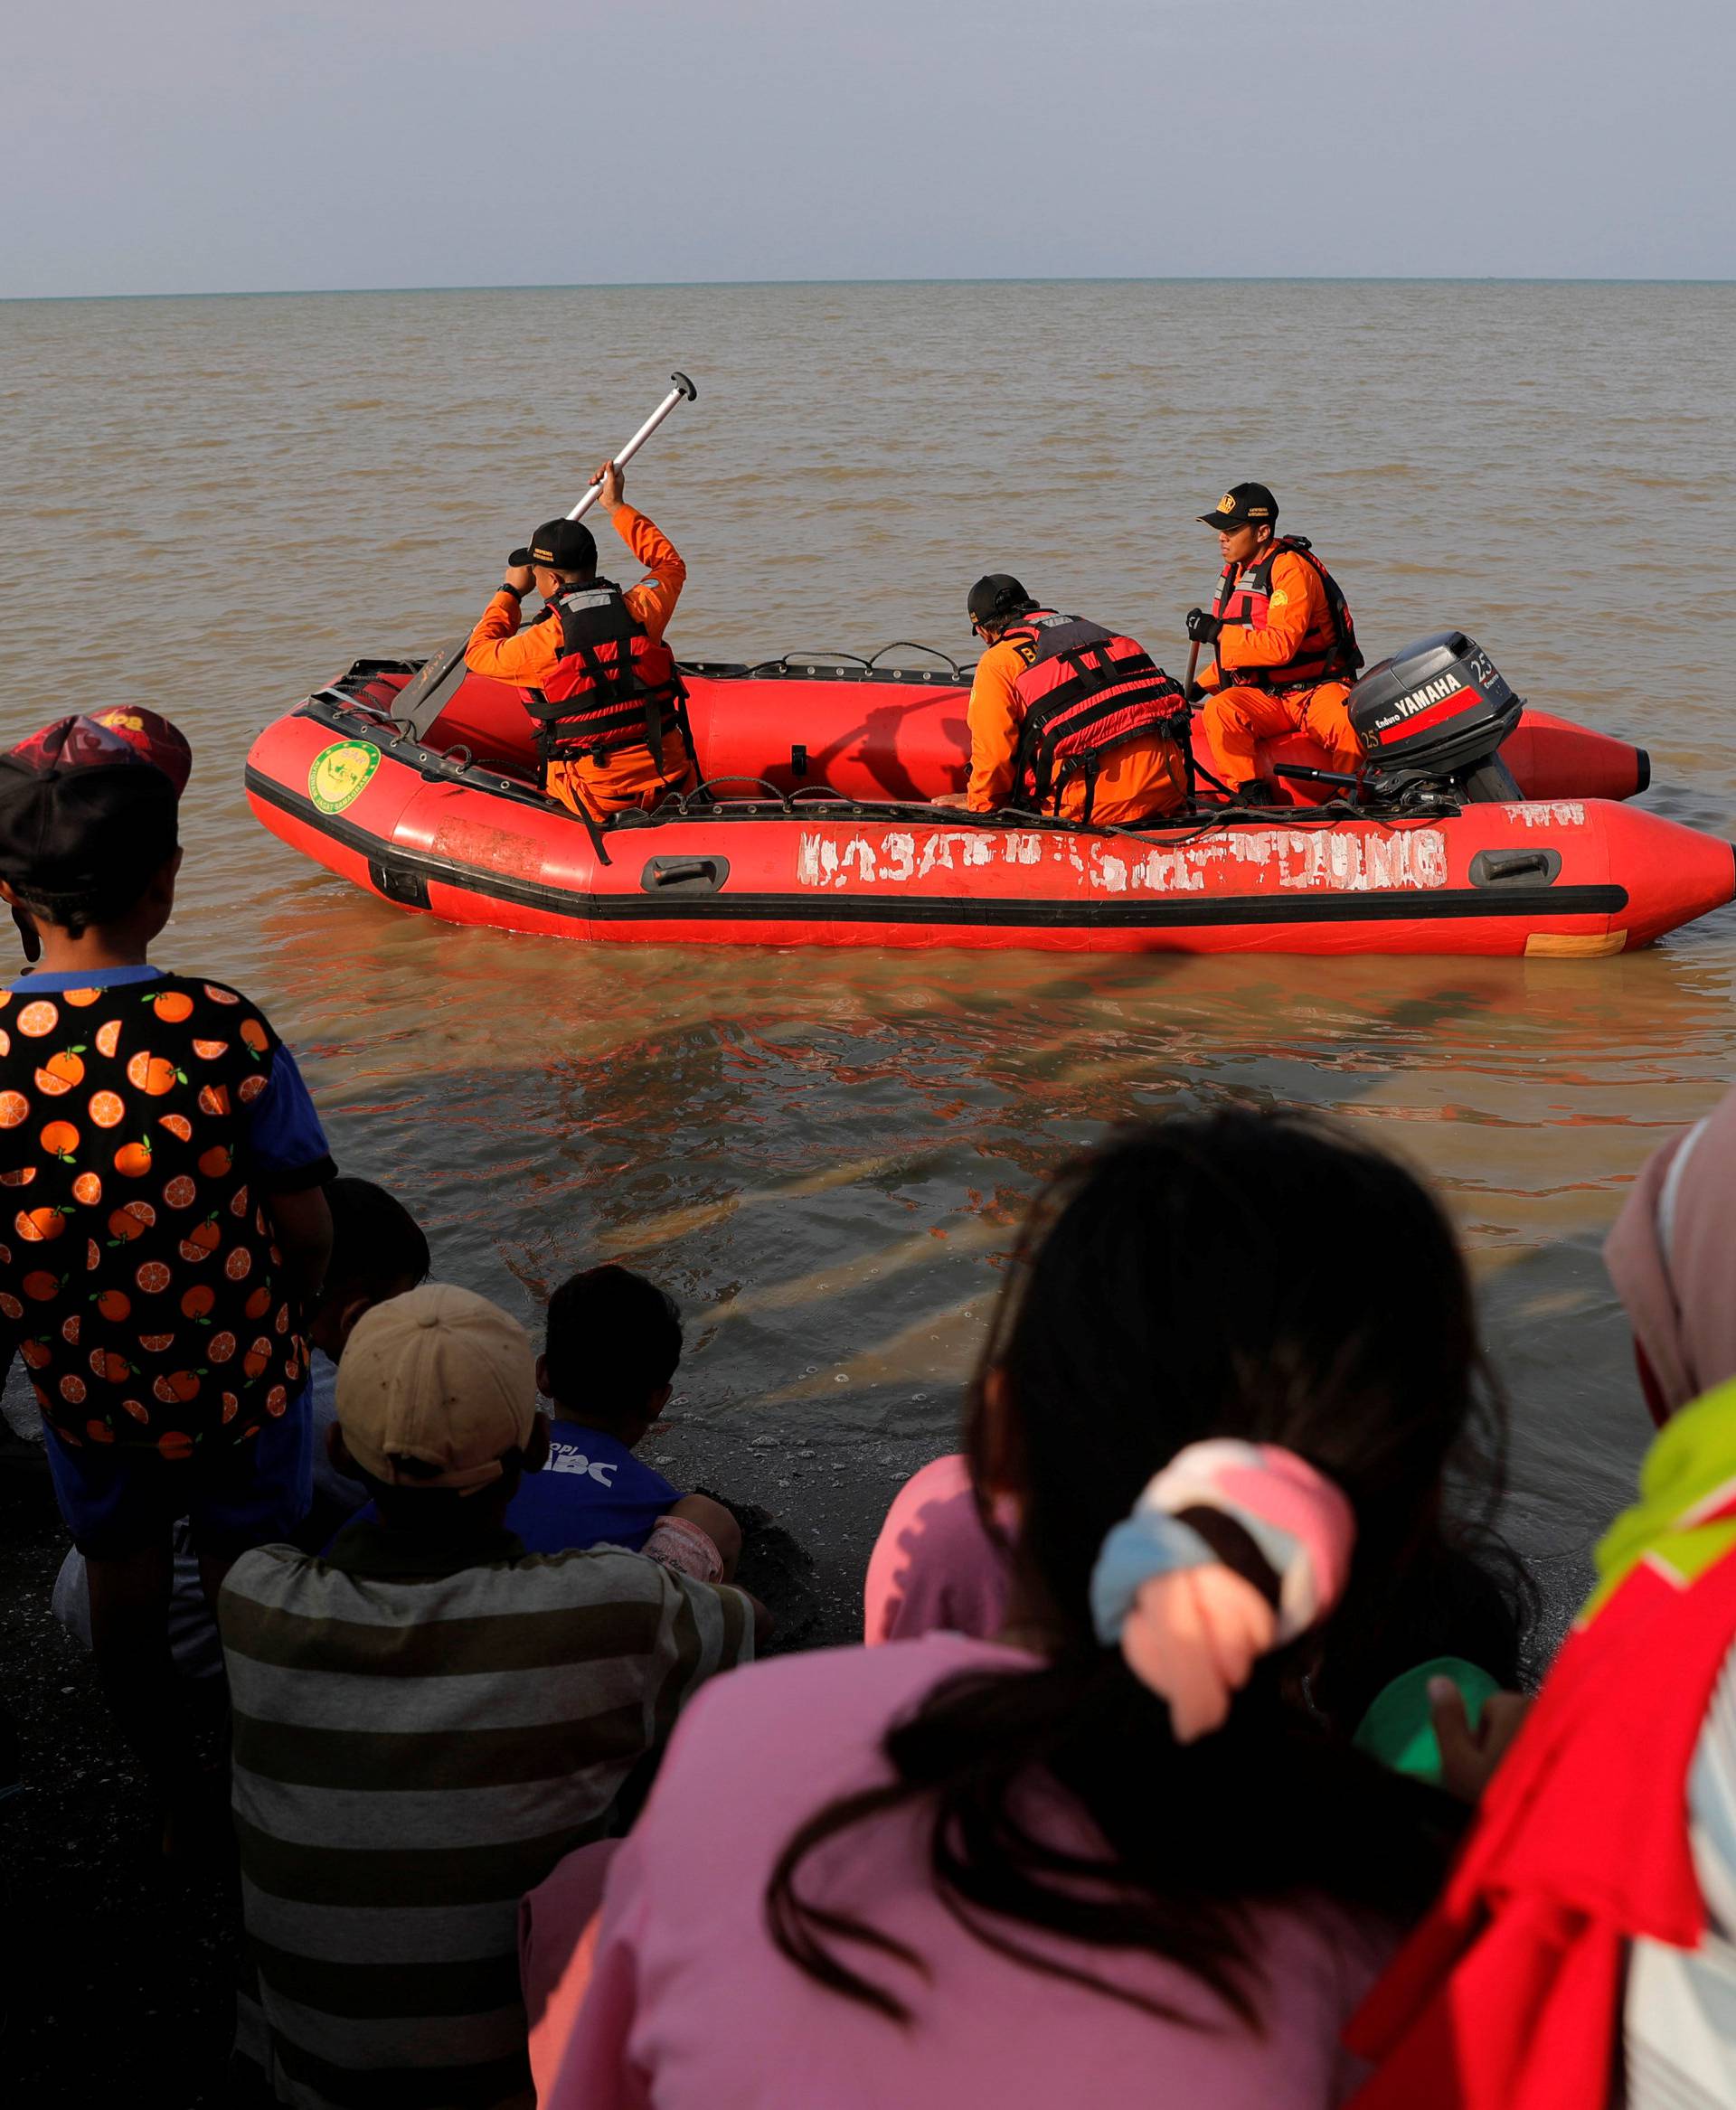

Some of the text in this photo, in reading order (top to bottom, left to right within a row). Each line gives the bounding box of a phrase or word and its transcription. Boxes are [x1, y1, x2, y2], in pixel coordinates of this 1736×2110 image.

[1471, 653, 1492, 683] 25
[1375, 674, 1461, 729] Enduro YAMAHA
[1362, 730, 1379, 749] 25
[549, 1442, 579, 1455] OPI
